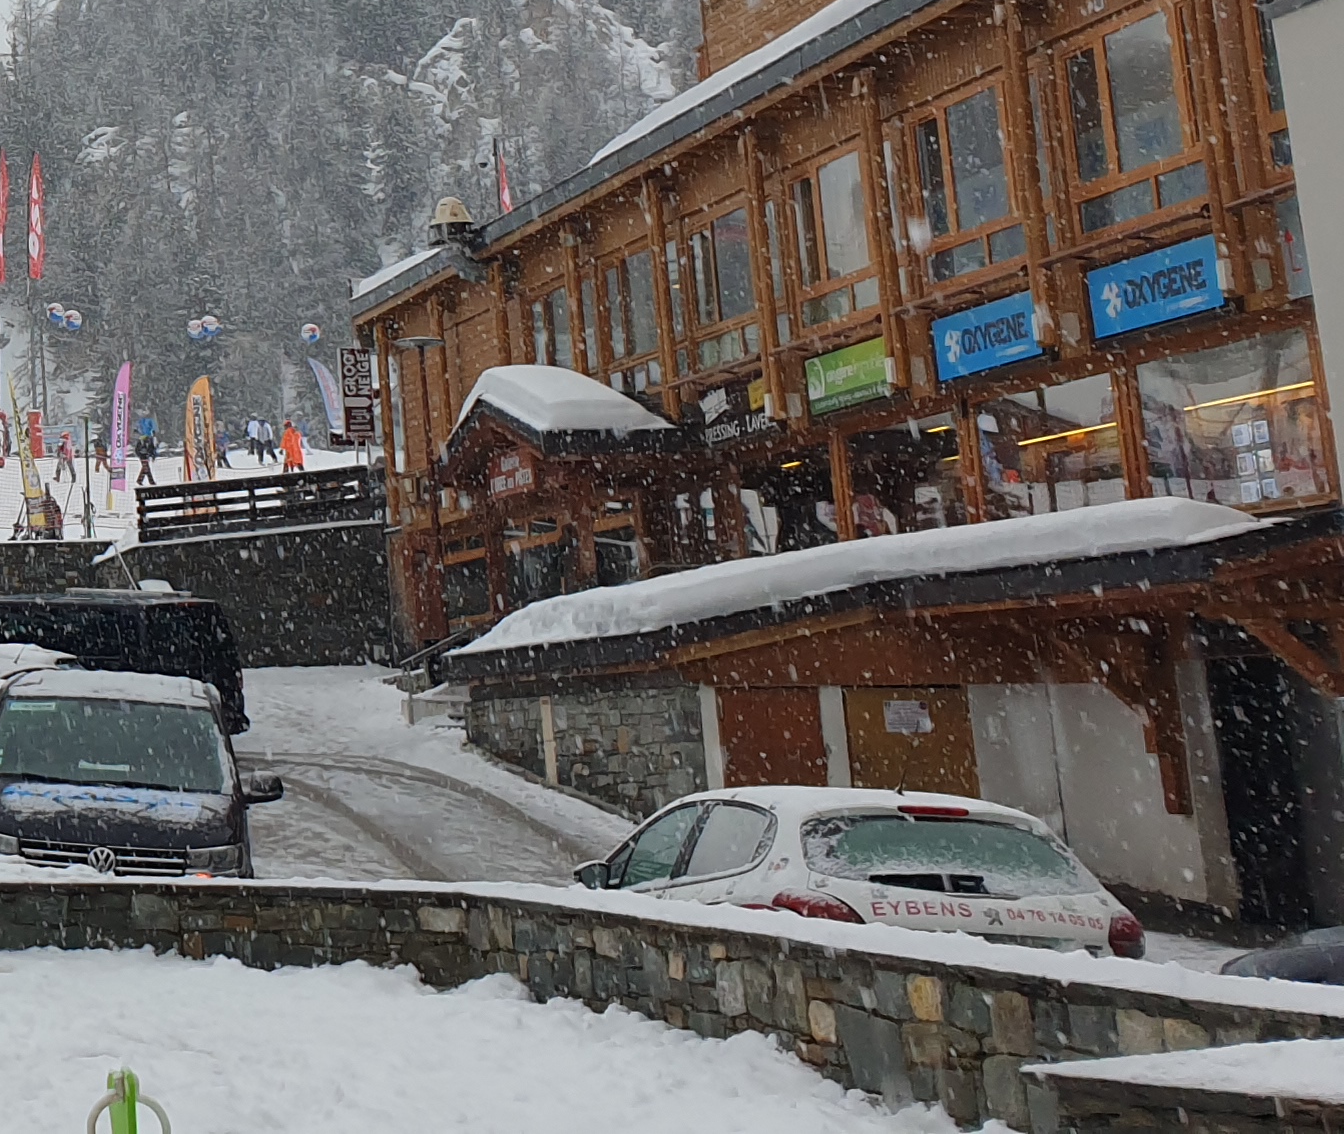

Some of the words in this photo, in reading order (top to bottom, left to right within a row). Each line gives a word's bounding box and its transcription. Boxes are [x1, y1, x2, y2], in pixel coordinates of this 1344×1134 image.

[1123, 258, 1207, 309] OXYGENE
[961, 312, 1029, 355] OXYGENE
[357, 352, 371, 395] NEIGE
[871, 900, 973, 918] EYBENS
[1006, 908, 1025, 921] 04
